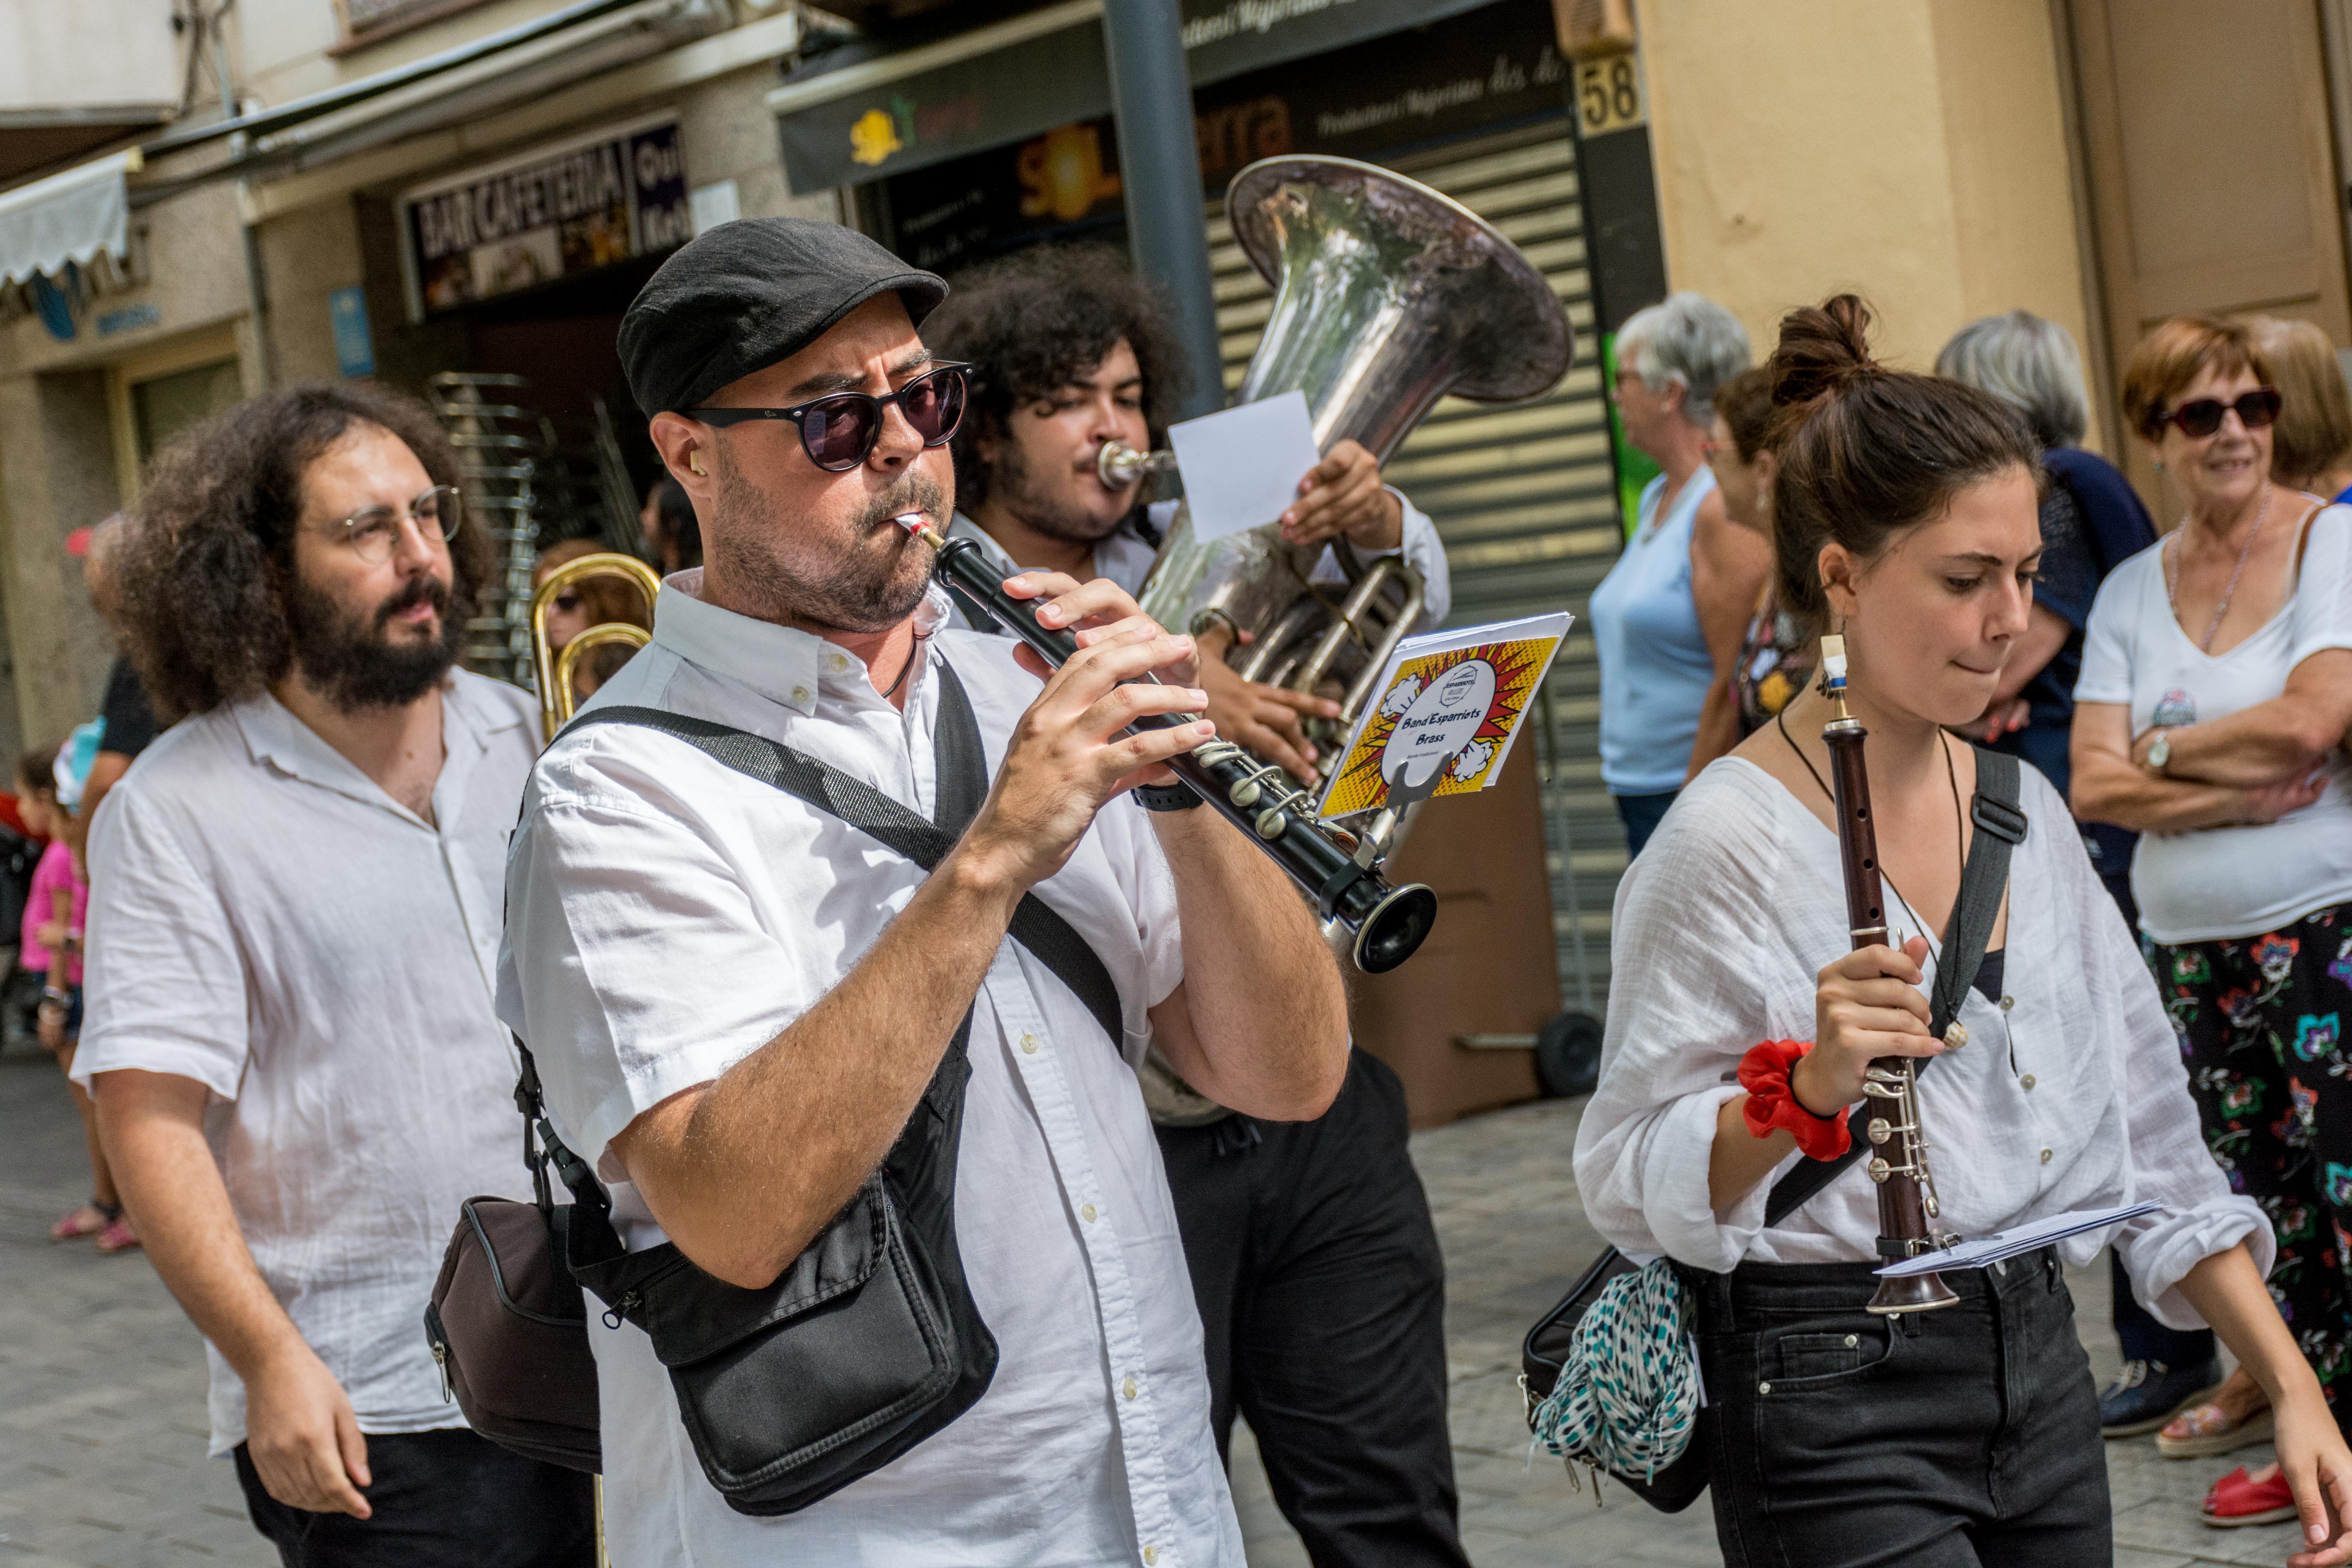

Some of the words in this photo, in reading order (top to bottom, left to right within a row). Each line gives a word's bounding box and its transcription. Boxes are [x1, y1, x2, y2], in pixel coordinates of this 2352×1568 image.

[1584, 56, 1638, 126] 58
[419, 193, 471, 260] BAR
[474, 140, 626, 242] CAFETERIA
[1446, 679, 1474, 688] ESPARRIOTS
[1416, 733, 1445, 746] Brass
